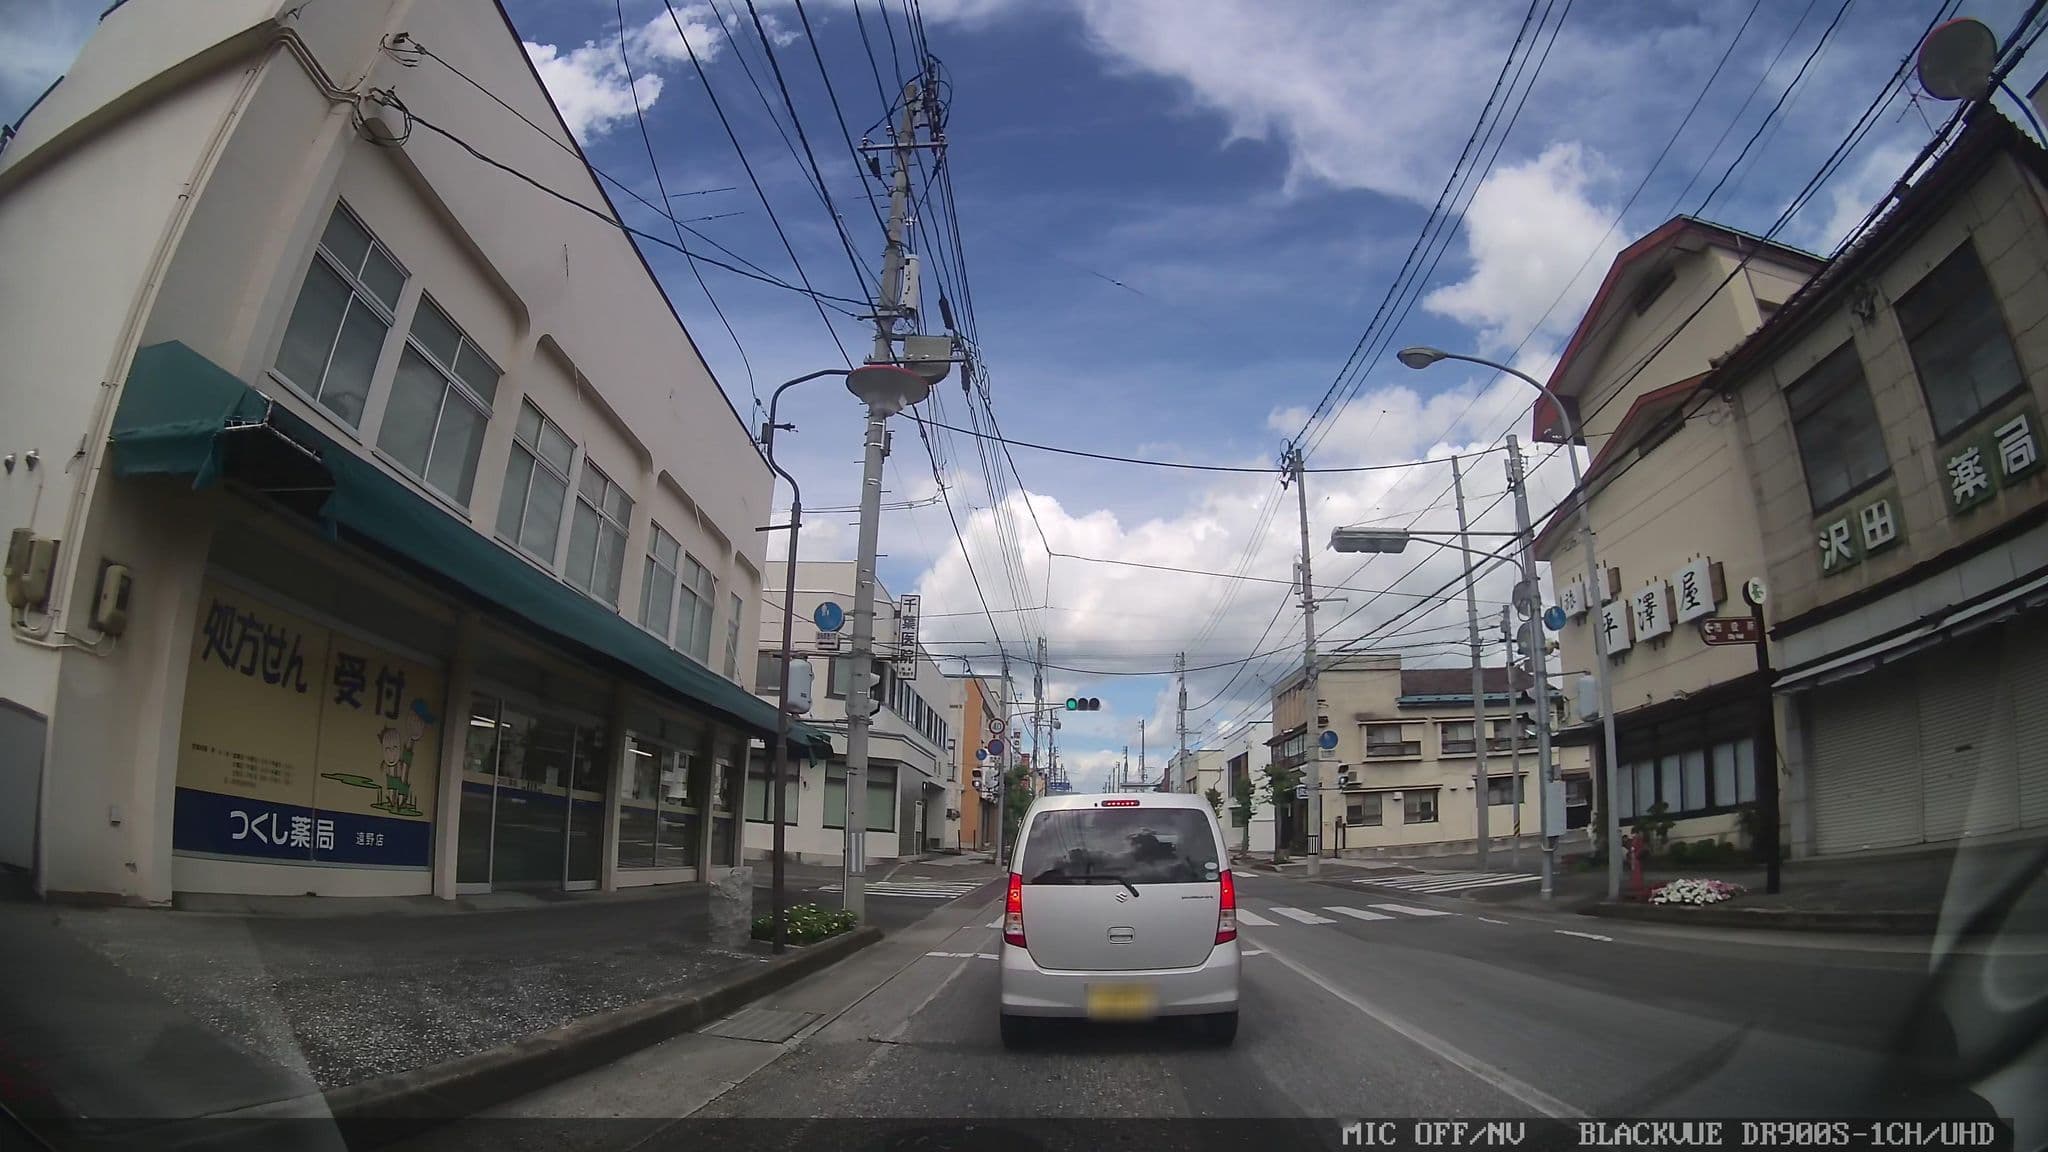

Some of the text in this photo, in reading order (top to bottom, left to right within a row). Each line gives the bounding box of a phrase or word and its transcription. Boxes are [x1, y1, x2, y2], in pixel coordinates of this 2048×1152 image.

[1818, 414, 2036, 571] 沢田 薬局
[202, 601, 406, 720] 処方せん 受付
[901, 598, 917, 664] 千葉医院
[230, 810, 384, 850] つくし薬局 遠野店
